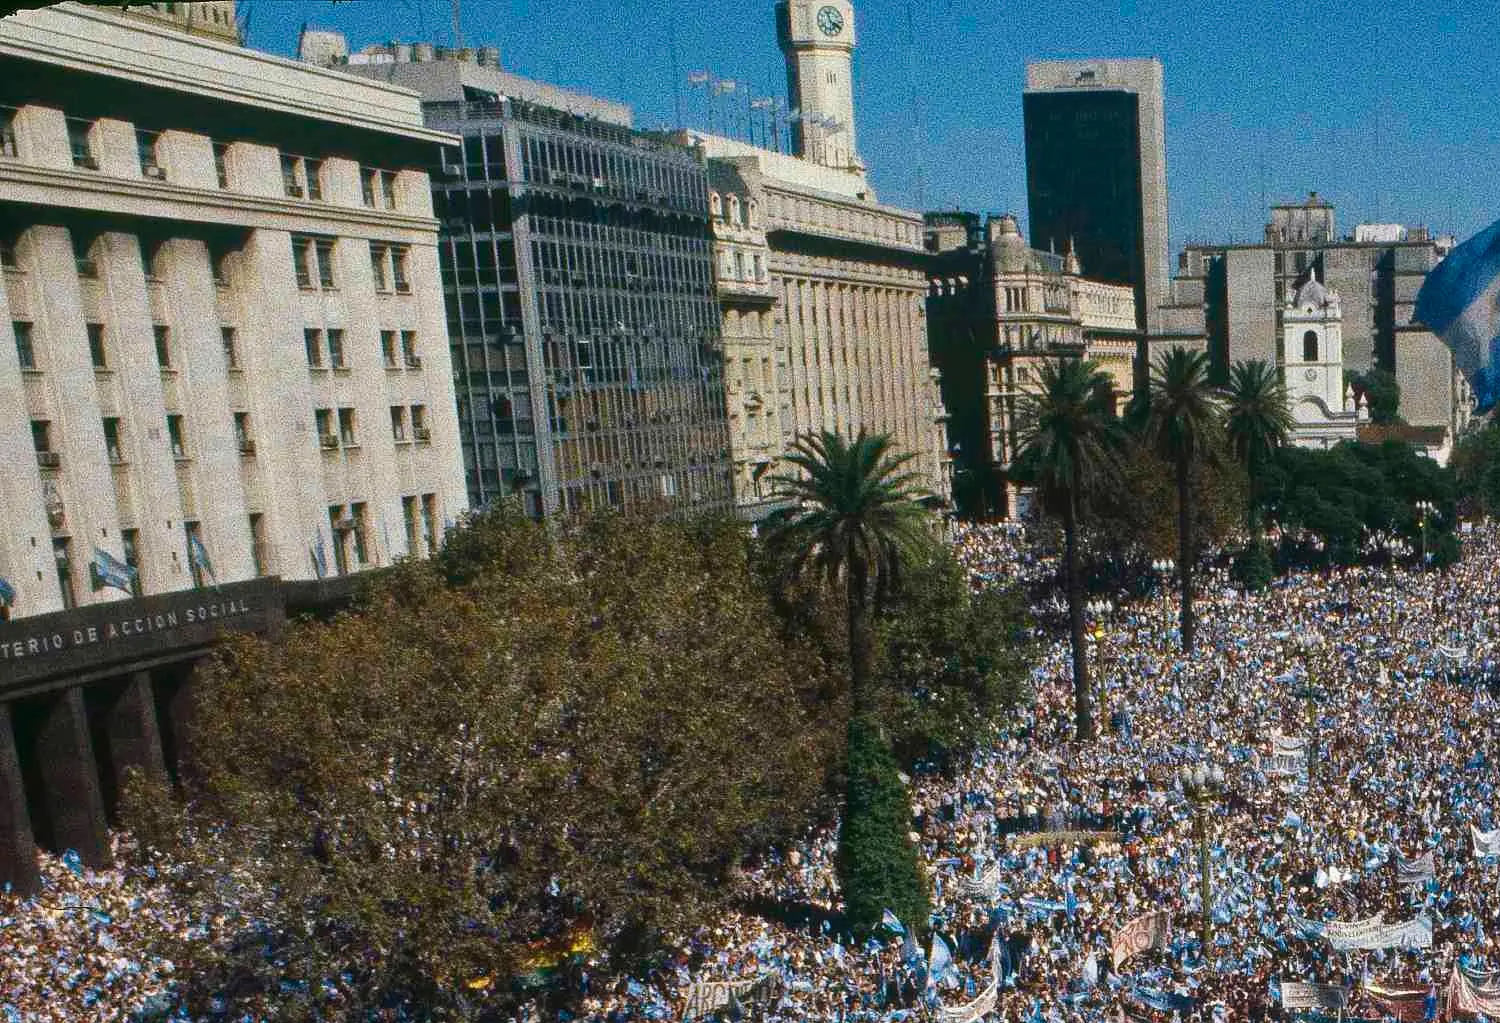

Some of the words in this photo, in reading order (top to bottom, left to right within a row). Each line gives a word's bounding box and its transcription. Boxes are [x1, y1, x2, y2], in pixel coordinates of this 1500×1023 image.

[73, 627, 98, 645] DE
[107, 610, 177, 640] ACCION
[185, 600, 249, 622] SOCIAL
